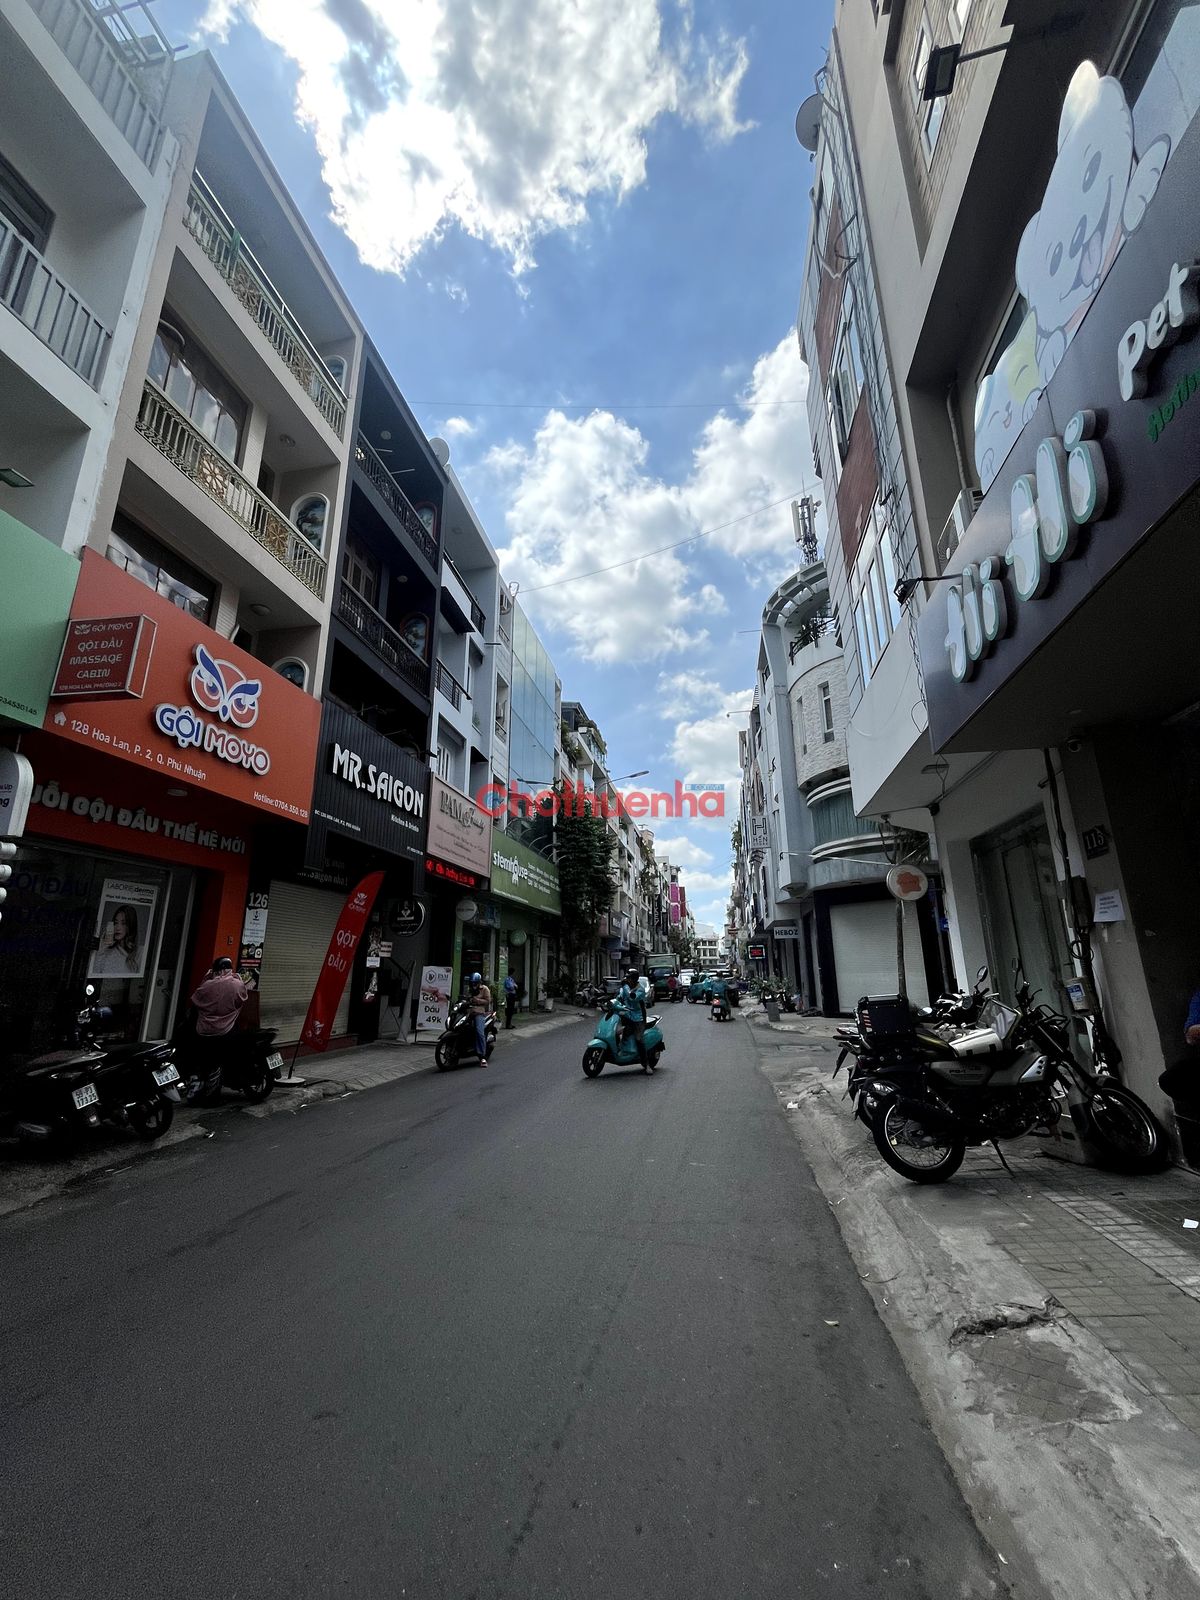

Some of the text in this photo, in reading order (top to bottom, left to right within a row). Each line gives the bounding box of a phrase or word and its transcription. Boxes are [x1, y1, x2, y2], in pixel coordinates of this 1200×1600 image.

[1118, 262, 1189, 402] Pet
[107, 622, 133, 631] MOYO
[76, 668, 111, 679] CABIN
[70, 719, 207, 781] 128 Hoa Lan, P. 2, Q. Phú Nhuận
[157, 705, 270, 773] GỘI MOYO
[72, 797, 114, 823] GỘI
[117, 807, 159, 833] ĐẦU
[163, 819, 198, 844] THẾ
[198, 829, 218, 850] HỆ
[220, 835, 246, 854] MỚI
[248, 891, 269, 908] 126
